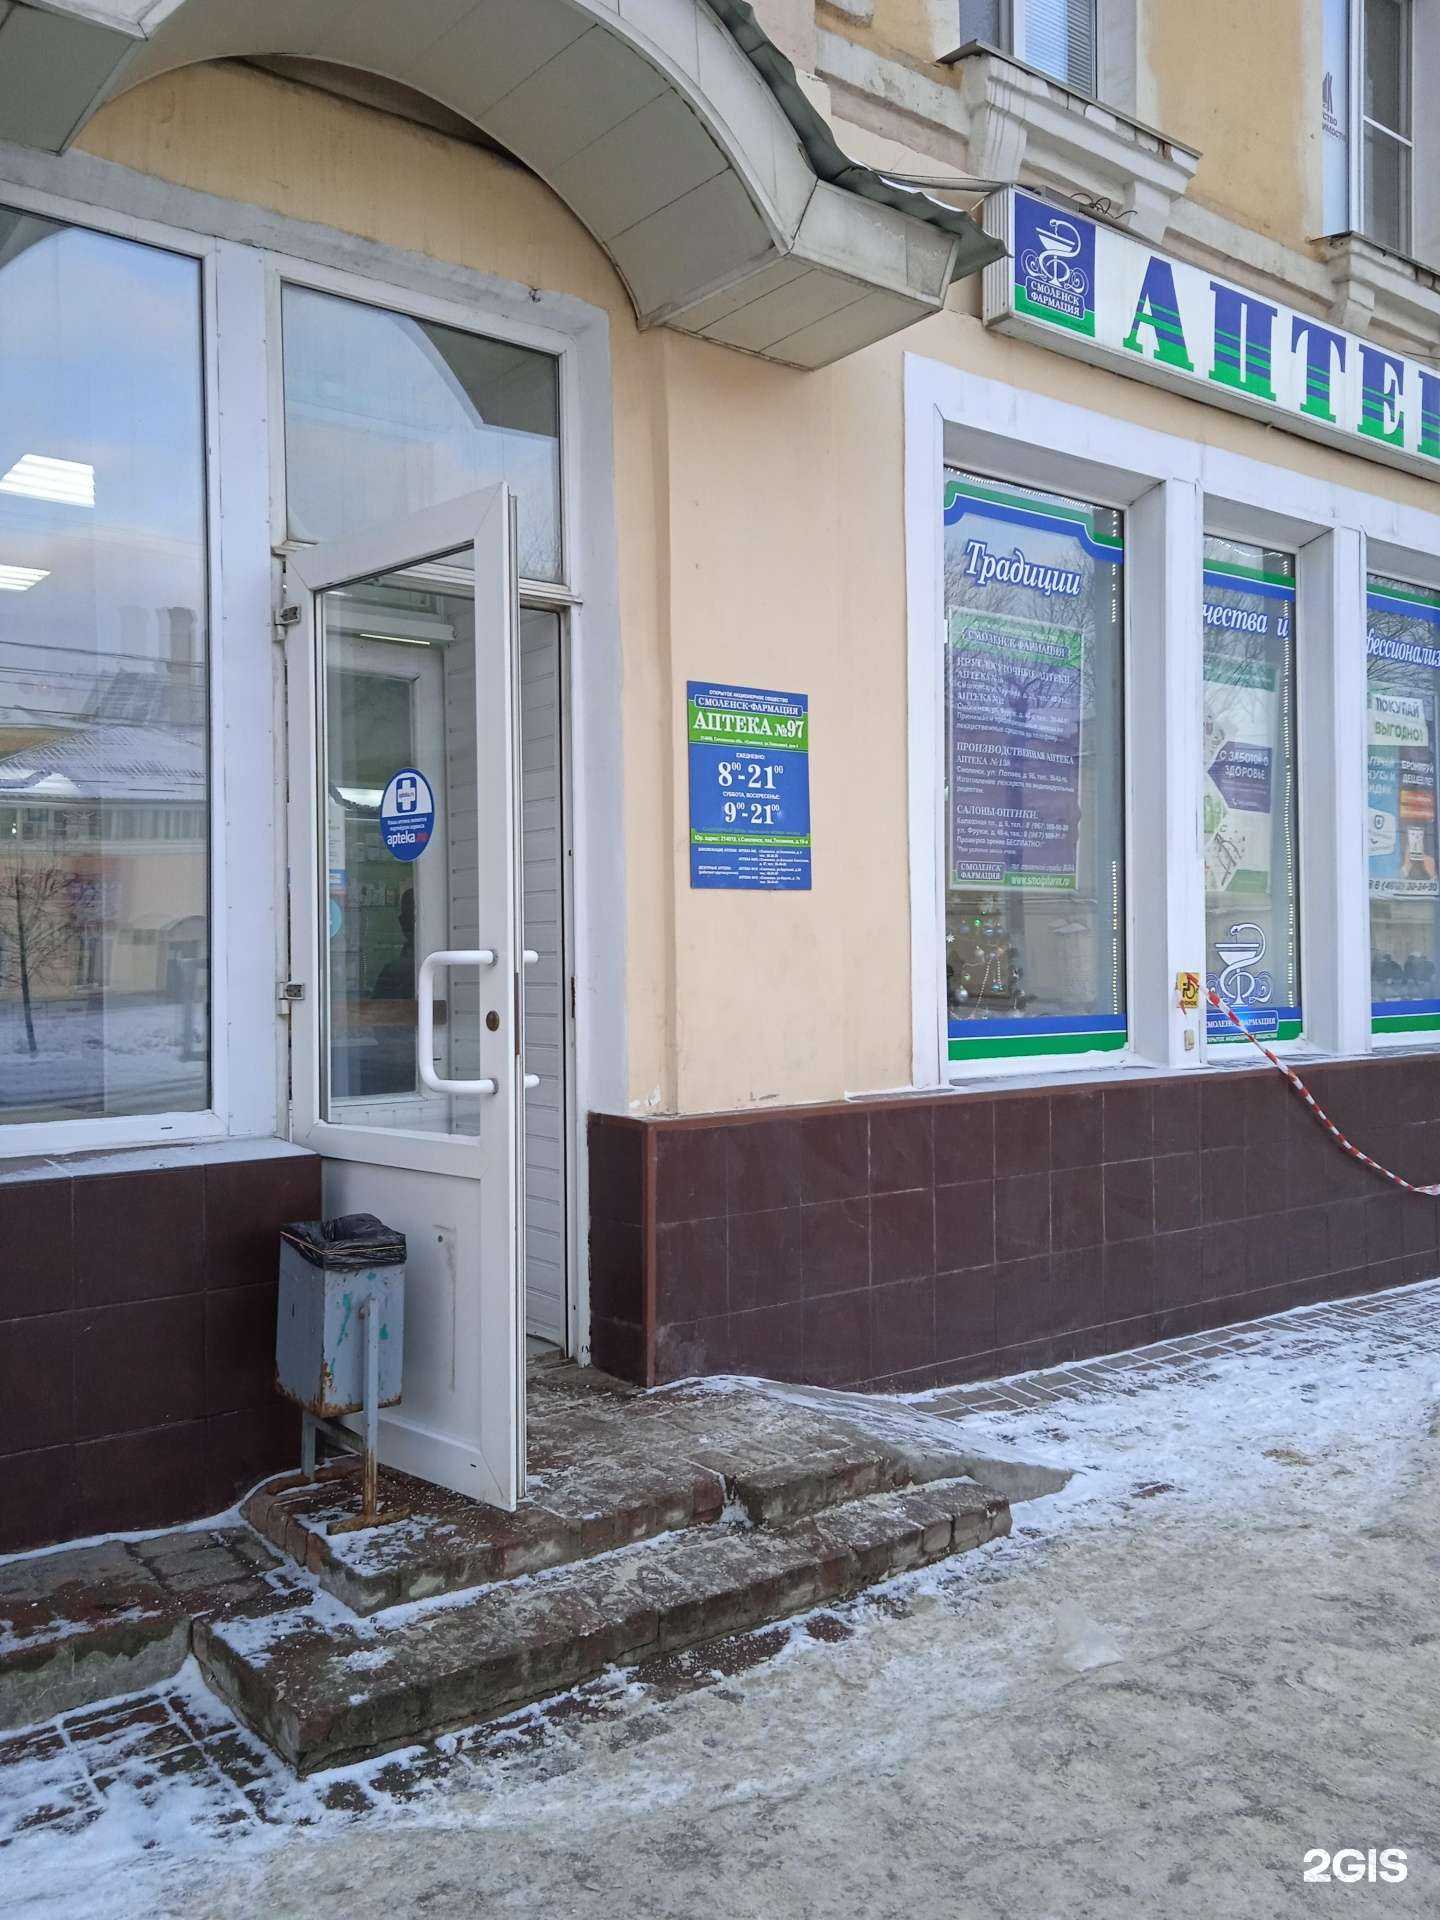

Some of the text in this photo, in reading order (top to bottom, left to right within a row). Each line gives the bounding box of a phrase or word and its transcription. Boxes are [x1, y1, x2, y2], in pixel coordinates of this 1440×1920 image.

[1030, 280, 1080, 306] СМОЛЕНСК
[1030, 290, 1081, 317] ФАРМАЦИЯ
[965, 541, 1082, 595] Традиции
[1276, 617, 1290, 637] и
[698, 697, 799, 716] СМОЛЕНСК-ФАРМАЦИЯ
[693, 711, 804, 738] АПТЕКА №97
[957, 755, 988, 766] АПТЕКА
[1219, 750, 1227, 761] С
[1224, 764, 1266, 780] ЗДОРОВЬЕ
[960, 862, 1002, 872] СМОЛЕНСК
[960, 870, 1001, 881] ФАРМАЦИЯ
